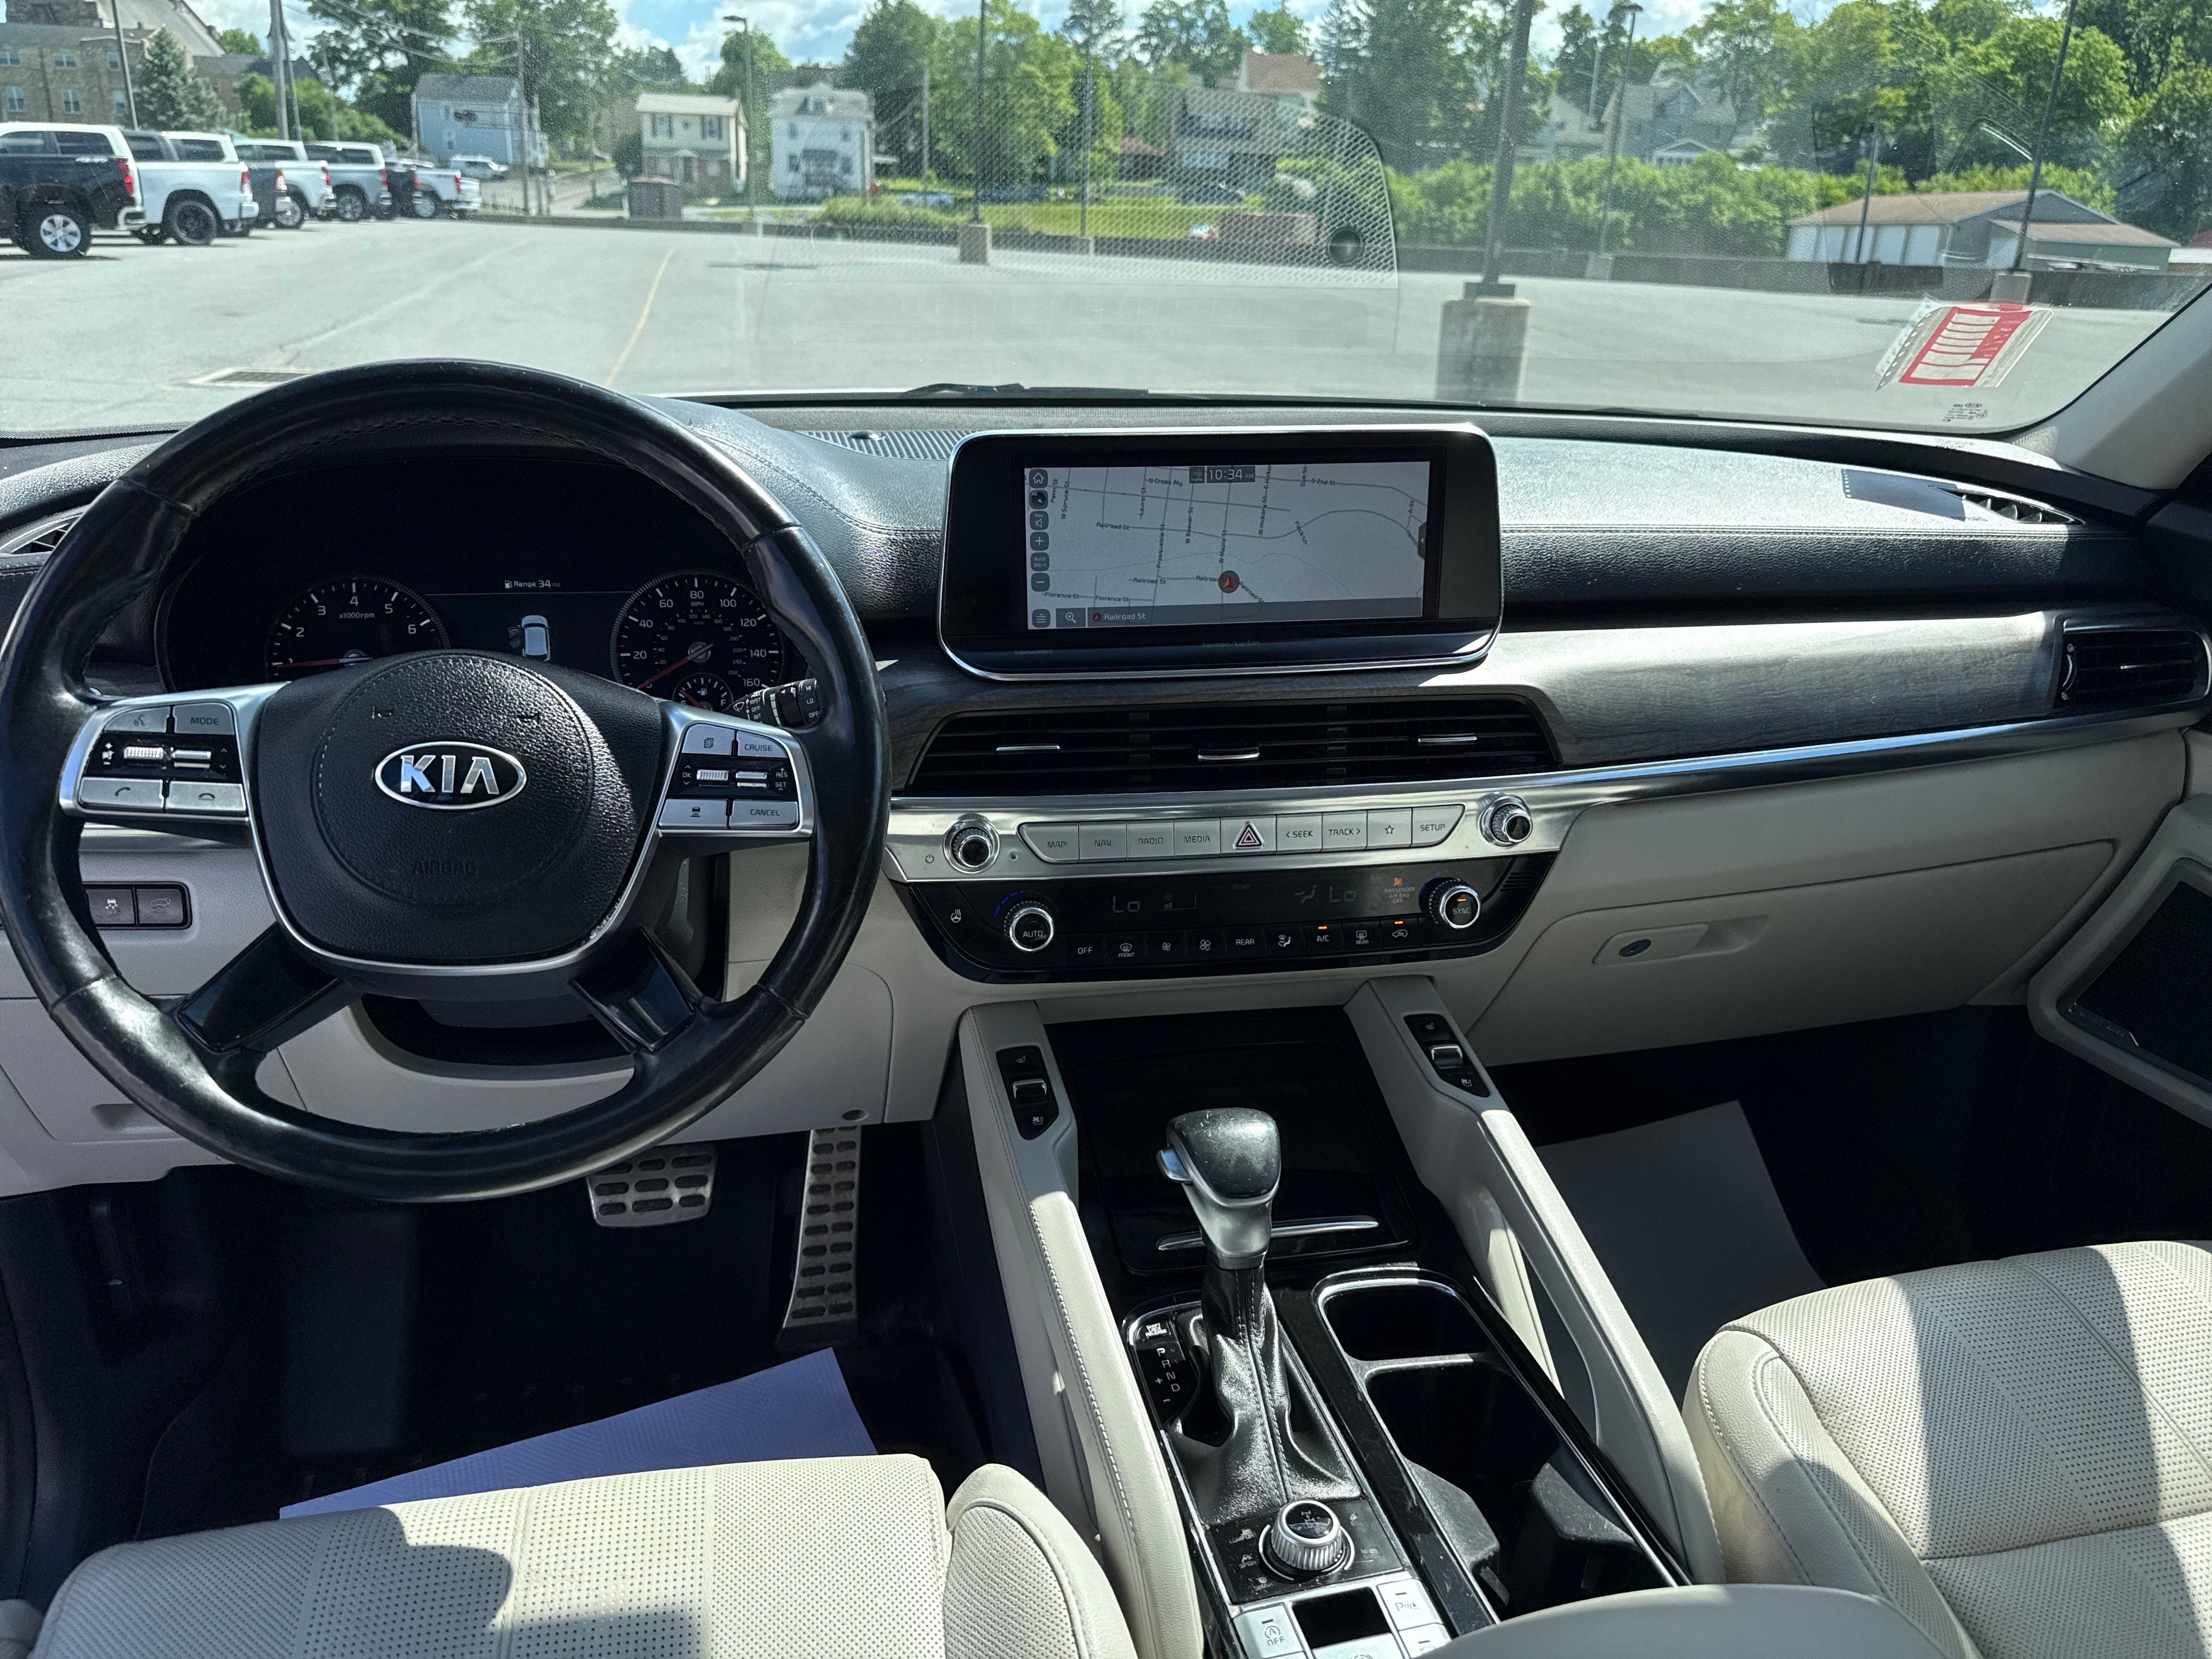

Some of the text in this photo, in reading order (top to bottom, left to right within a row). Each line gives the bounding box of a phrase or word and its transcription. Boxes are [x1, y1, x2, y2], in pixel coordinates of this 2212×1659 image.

[1209, 469, 1243, 479] 10:34
[1295, 521, 1308, 544] Fleck Ln
[538, 580, 551, 588] 34
[690, 591, 704, 599] 80
[1239, 582, 1258, 599] Railroad
[350, 596, 359, 606] 4
[659, 599, 674, 608] 60
[720, 599, 736, 608] 100
[318, 606, 326, 616] 3
[385, 604, 393, 613] 5
[741, 618, 757, 627] 120
[296, 628, 304, 637] 2
[408, 624, 416, 634] 6
[633, 651, 647, 659] 20
[749, 649, 766, 657] 140
[743, 678, 760, 687] 160
[190, 717, 219, 725] MODE
[744, 743, 772, 752] CRUISE
[400, 755, 499, 795] KIA
[1329, 827, 1355, 836] TRACK
[1420, 823, 1446, 833] SETUP
[1293, 830, 1313, 838] SEEK
[1094, 839, 1111, 847] NAV
[1184, 835, 1211, 844] MEDIA
[1048, 840, 1066, 849] MAP
[1156, 1347, 1166, 1356] P
[1162, 1359, 1171, 1368] R
[1166, 1372, 1176, 1380] N
[1171, 1384, 1180, 1392] D
[1266, 1636, 1285, 1646] OFF
